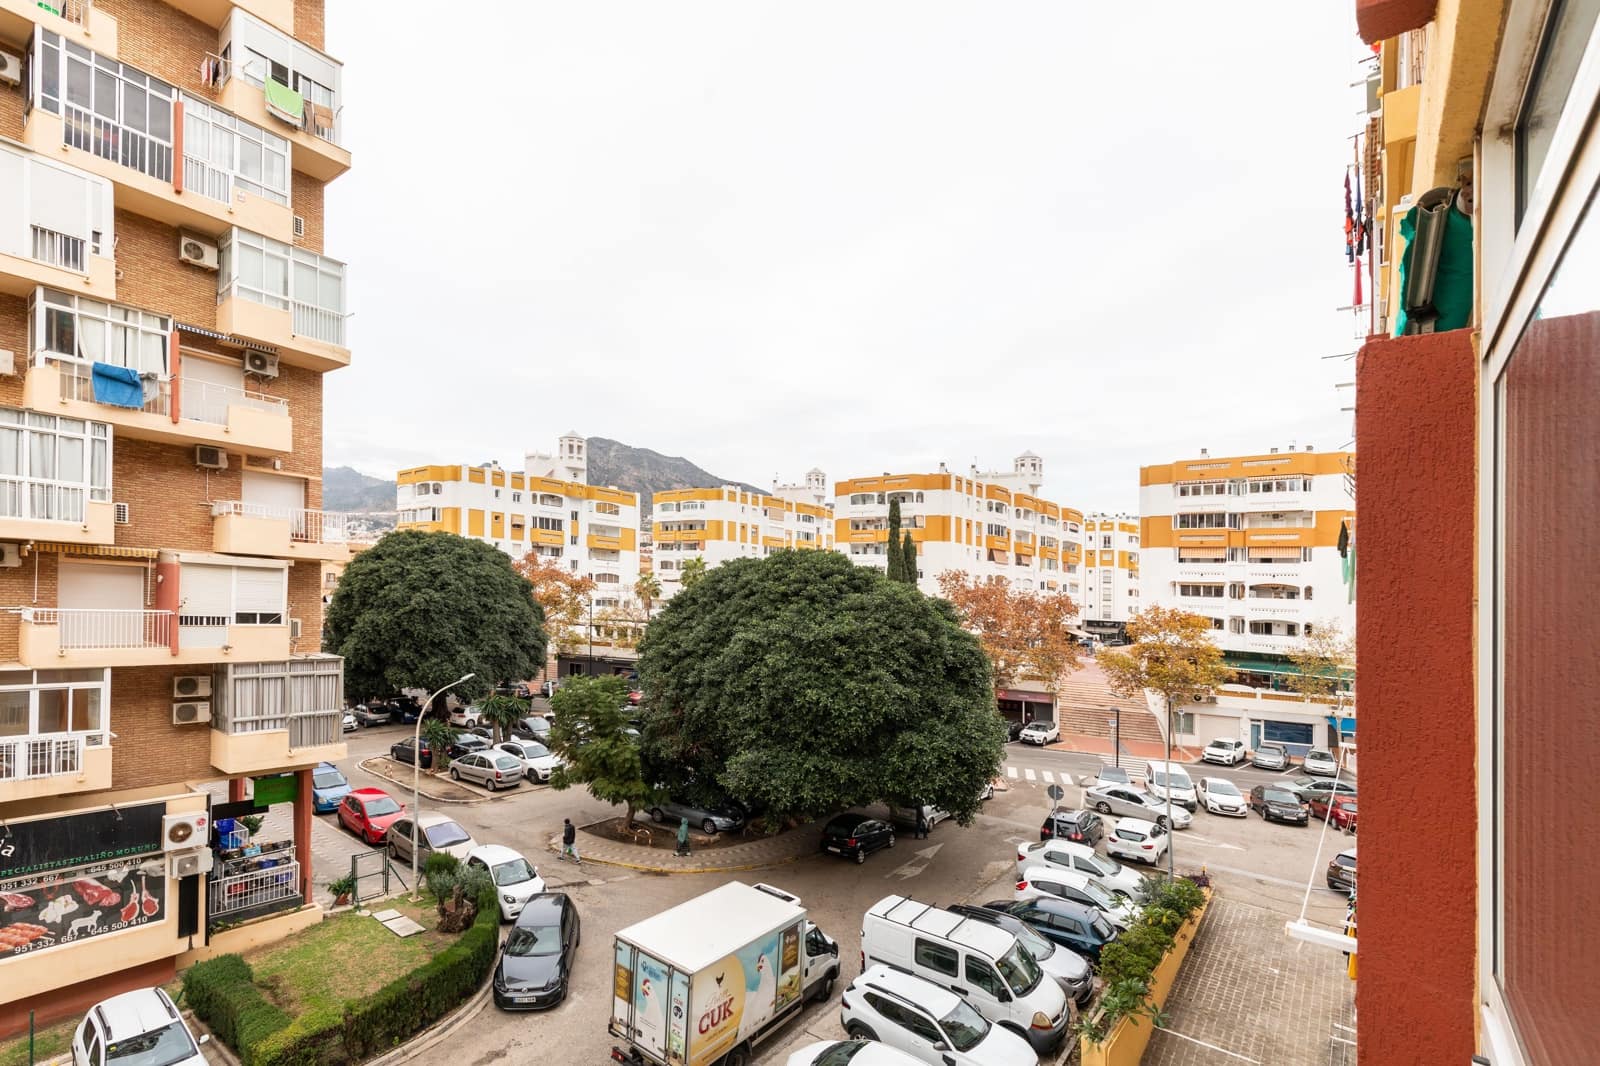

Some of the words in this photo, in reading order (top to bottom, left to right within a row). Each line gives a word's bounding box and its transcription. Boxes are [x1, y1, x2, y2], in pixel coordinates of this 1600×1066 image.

[14, 943, 33, 954] 951
[36, 939, 55, 949] 332
[90, 925, 109, 935] 645
[111, 921, 128, 930] 500
[130, 916, 148, 926] 410
[698, 996, 735, 1035] CUK
